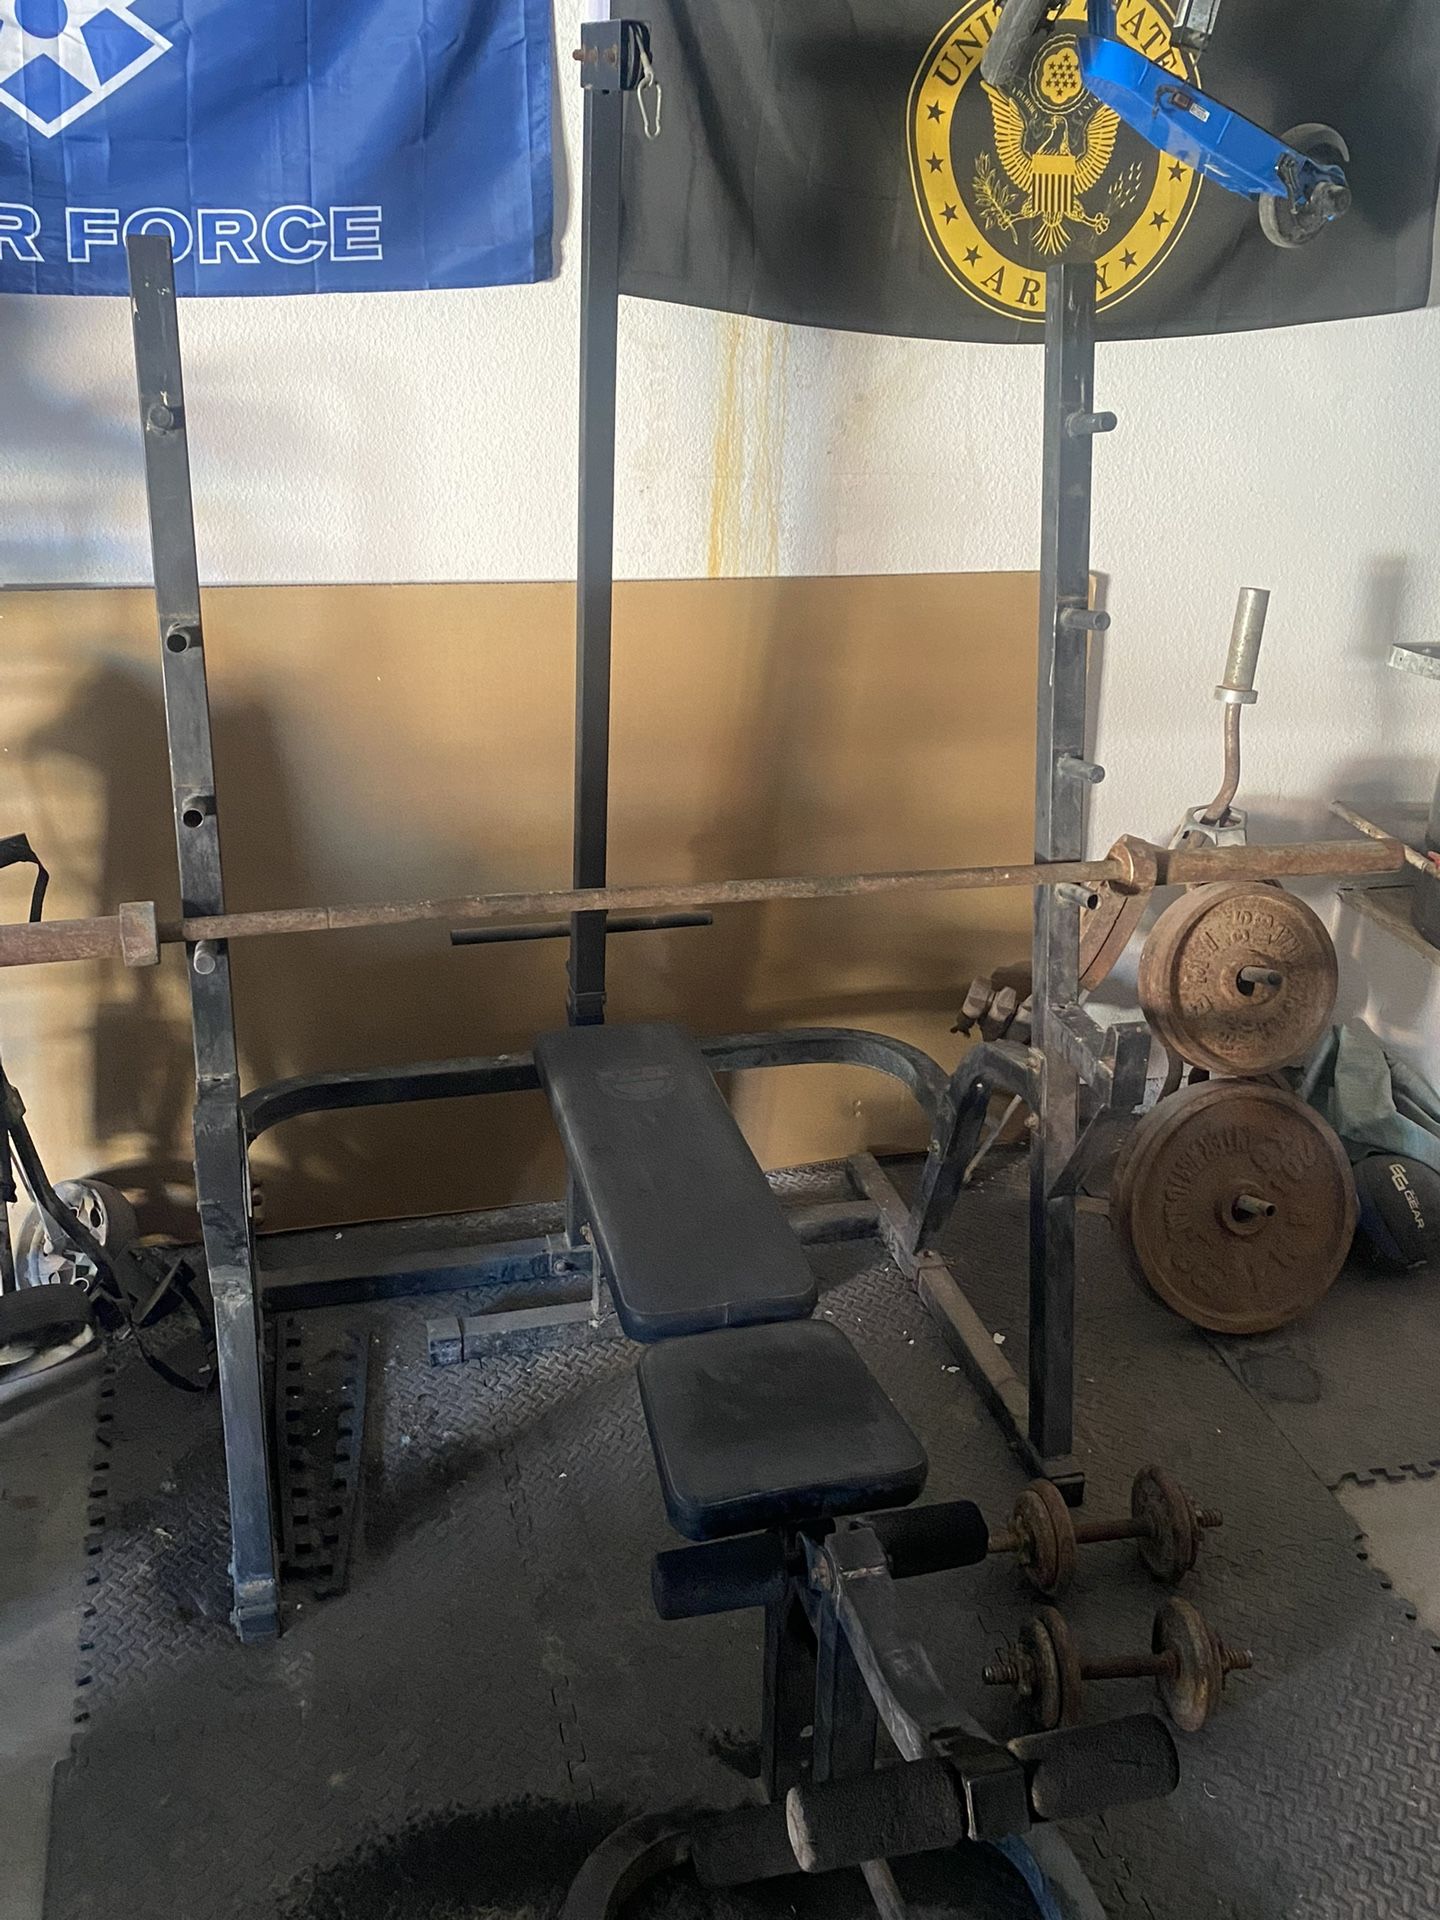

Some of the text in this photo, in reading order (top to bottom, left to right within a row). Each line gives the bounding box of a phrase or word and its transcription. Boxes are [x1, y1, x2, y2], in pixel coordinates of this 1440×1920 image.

[65, 205, 383, 265] FORCE
[980, 262, 1112, 306] ARY
[1403, 1190, 1425, 1229] GEAR
